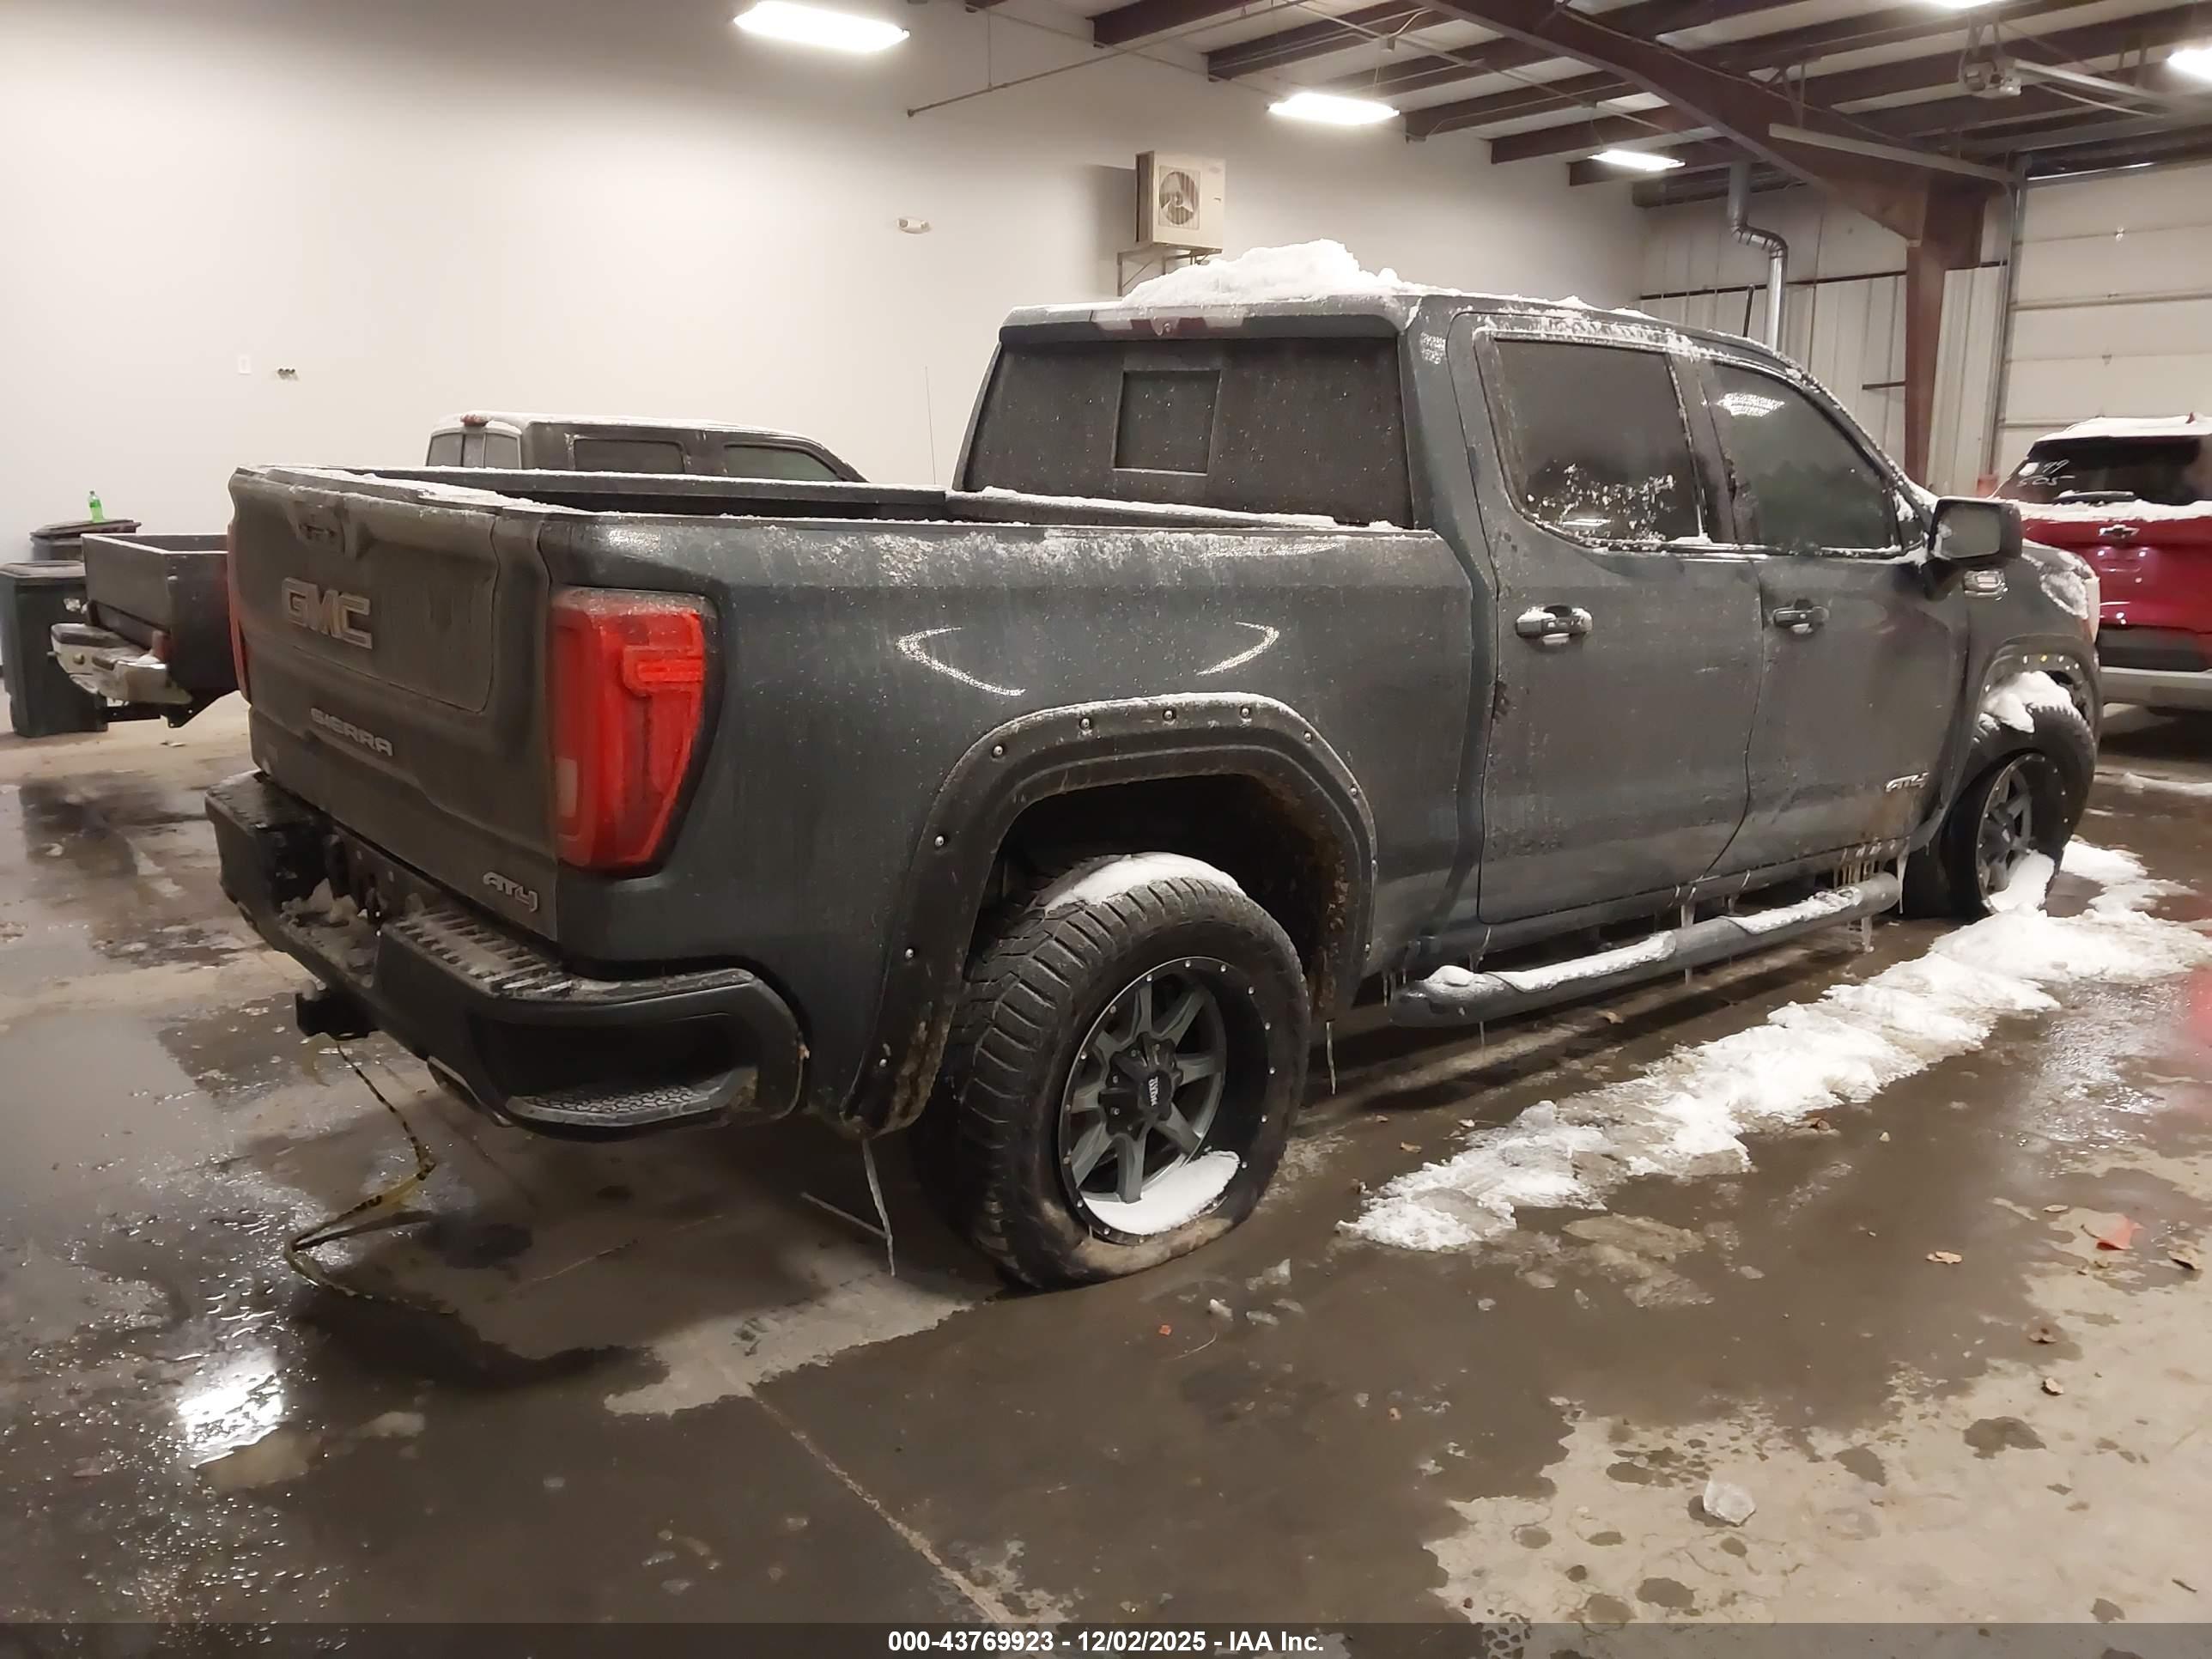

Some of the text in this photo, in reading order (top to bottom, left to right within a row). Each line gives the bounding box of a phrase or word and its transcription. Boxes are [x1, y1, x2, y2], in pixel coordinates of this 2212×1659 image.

[282, 576, 373, 649] GMC
[310, 708, 393, 757] SIERRA
[1885, 769, 1930, 793] AT4
[483, 871, 538, 914] AT4
